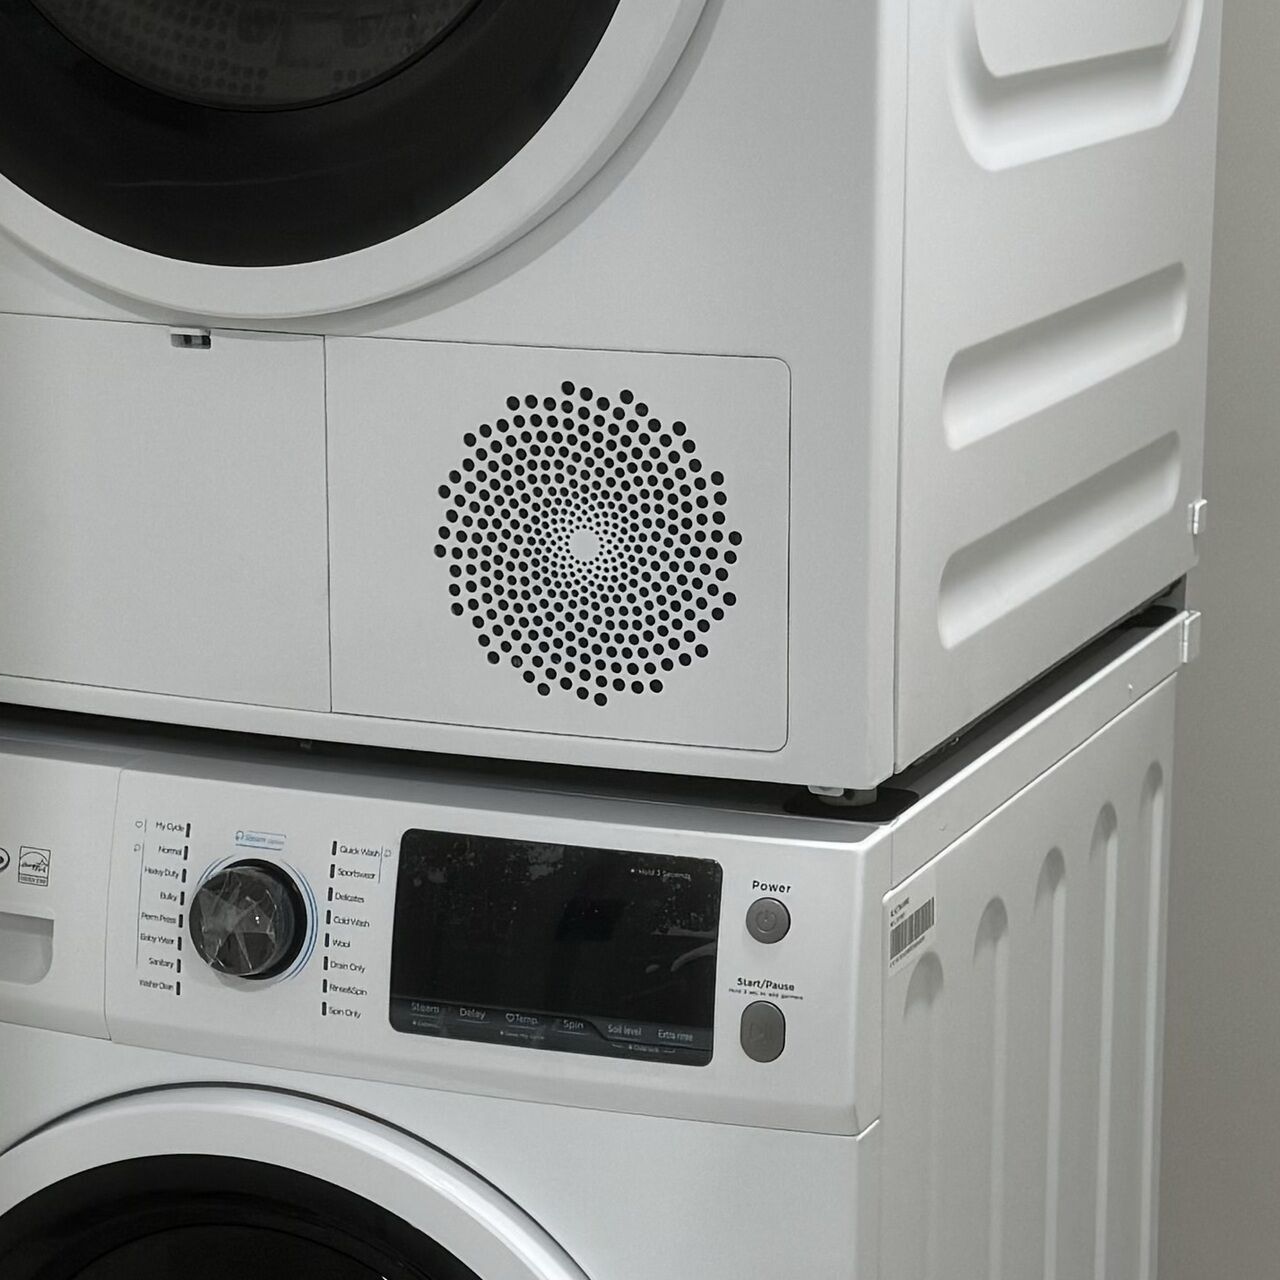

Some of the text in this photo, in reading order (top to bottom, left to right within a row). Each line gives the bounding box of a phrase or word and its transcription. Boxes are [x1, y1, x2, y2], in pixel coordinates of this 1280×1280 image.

[167, 822, 184, 832] Cycle
[340, 845, 380, 857] Quick Wash
[338, 867, 375, 879] Sportswear
[752, 880, 791, 894] Power
[335, 891, 365, 903] Delicates
[333, 915, 370, 927] Cold Wash
[332, 939, 351, 948] Wool
[330, 960, 366, 973] Drain Only
[737, 977, 795, 991] Start/Pause
[411, 1001, 440, 1013] Steam
[345, 1009, 362, 1019] Only
[460, 1008, 486, 1020] Delay
[563, 1020, 584, 1030] Spin
